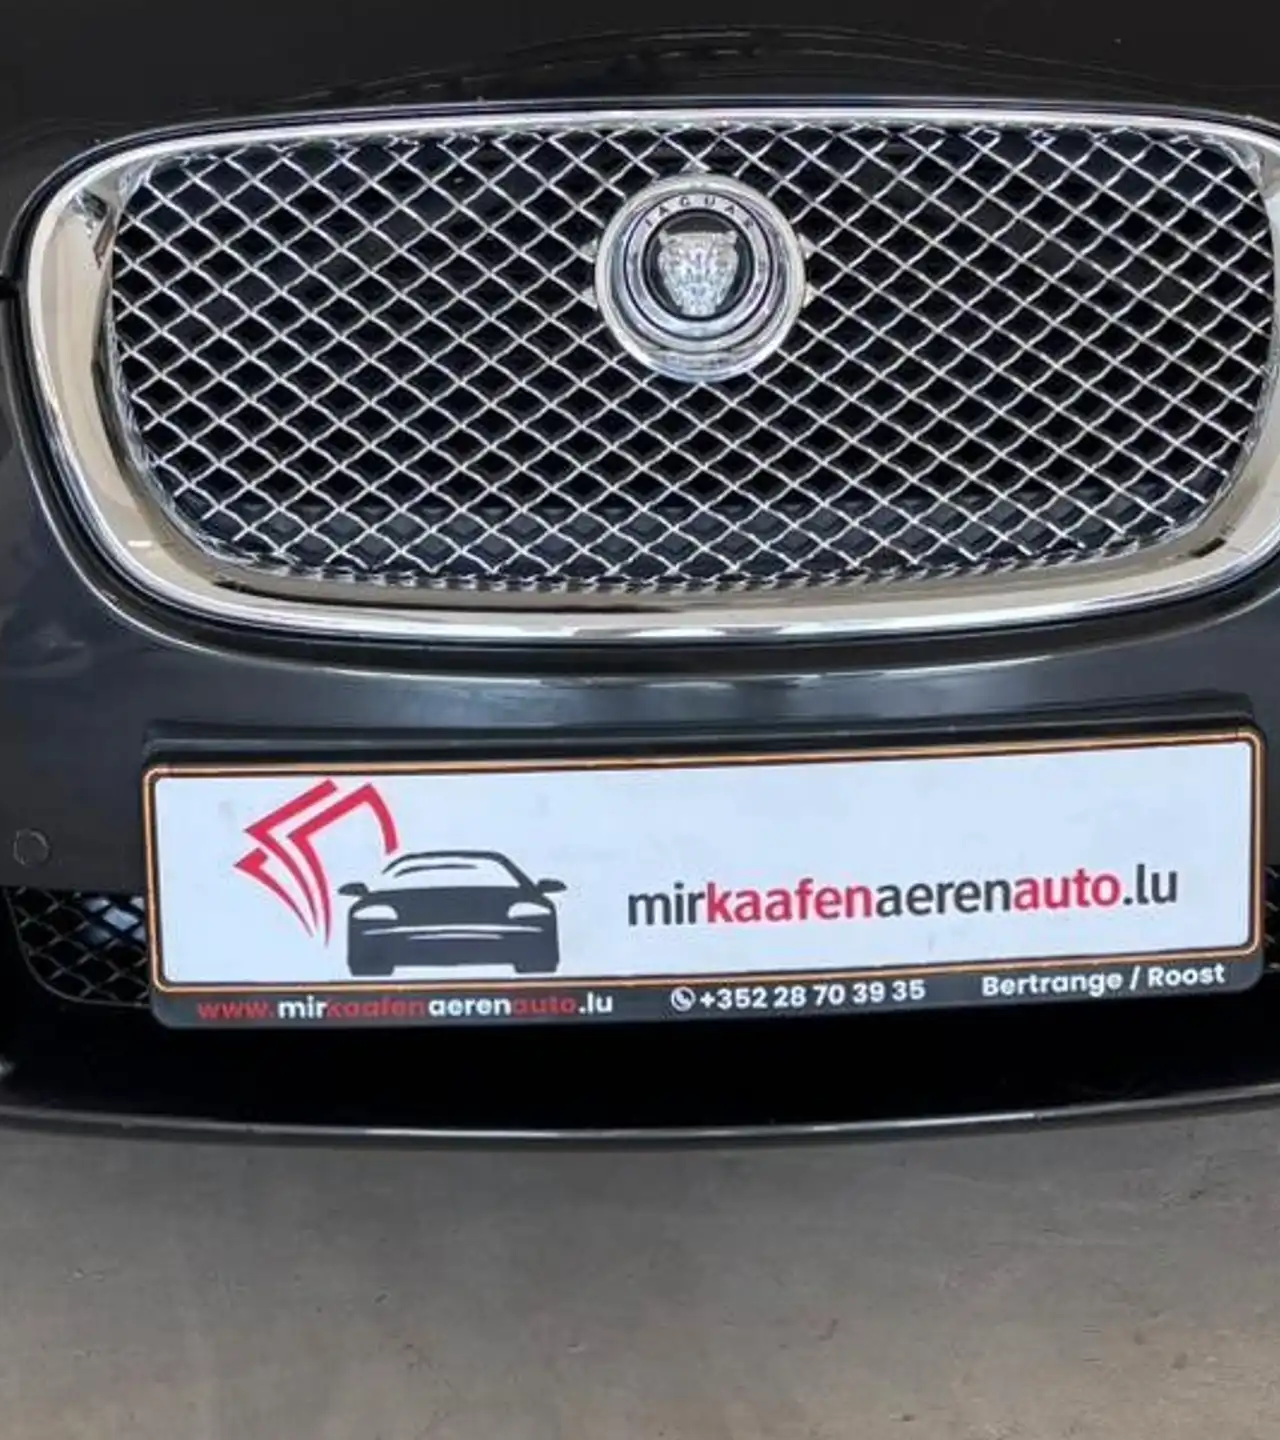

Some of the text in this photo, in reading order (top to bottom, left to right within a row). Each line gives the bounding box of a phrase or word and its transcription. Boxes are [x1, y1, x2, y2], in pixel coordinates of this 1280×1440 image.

[627, 862, 1178, 926] mirkaafenaerenauto.lu
[700, 979, 926, 1010] +352 28 70 39 35
[981, 962, 1226, 998] Bertrange / Roost
[196, 992, 614, 1021] www.mirkaafenaerenauto.lu
